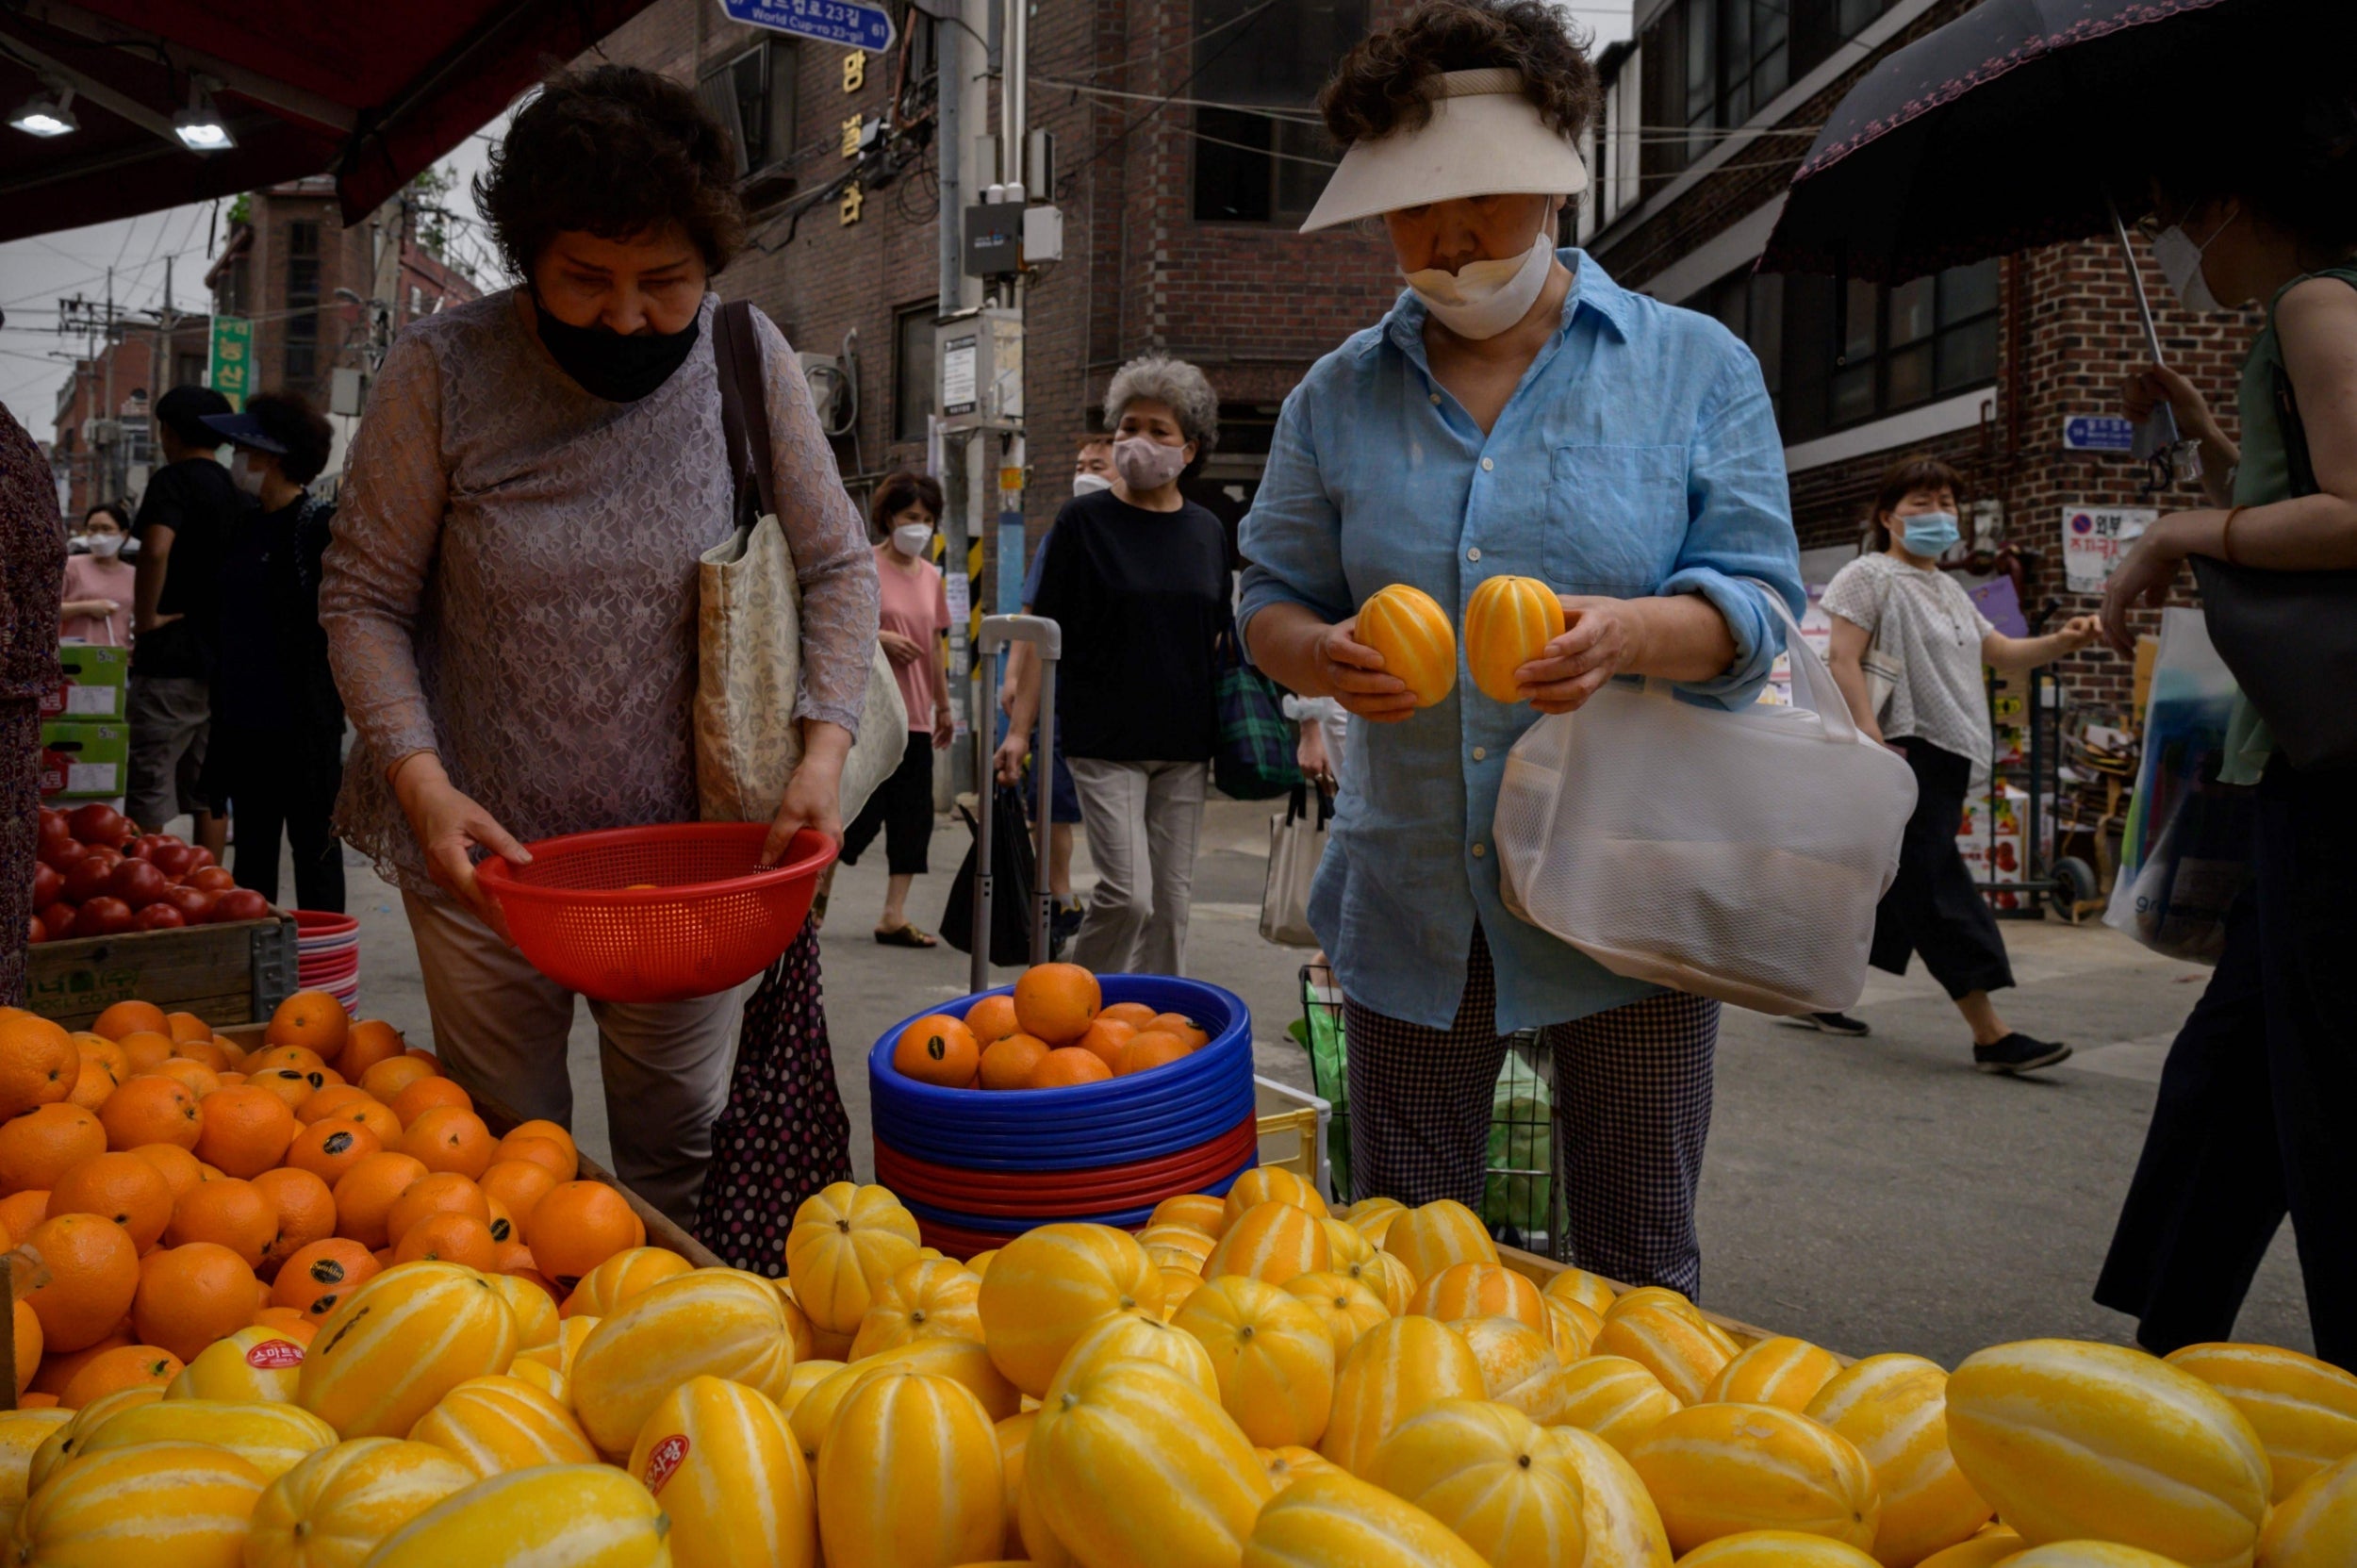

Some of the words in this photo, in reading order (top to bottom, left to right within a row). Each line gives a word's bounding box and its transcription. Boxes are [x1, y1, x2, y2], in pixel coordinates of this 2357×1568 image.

[752, 8, 787, 25] World
[788, 15, 830, 36] Cup-ro
[871, 23, 885, 39] 61
[2096, 515, 2121, 536] 외부
